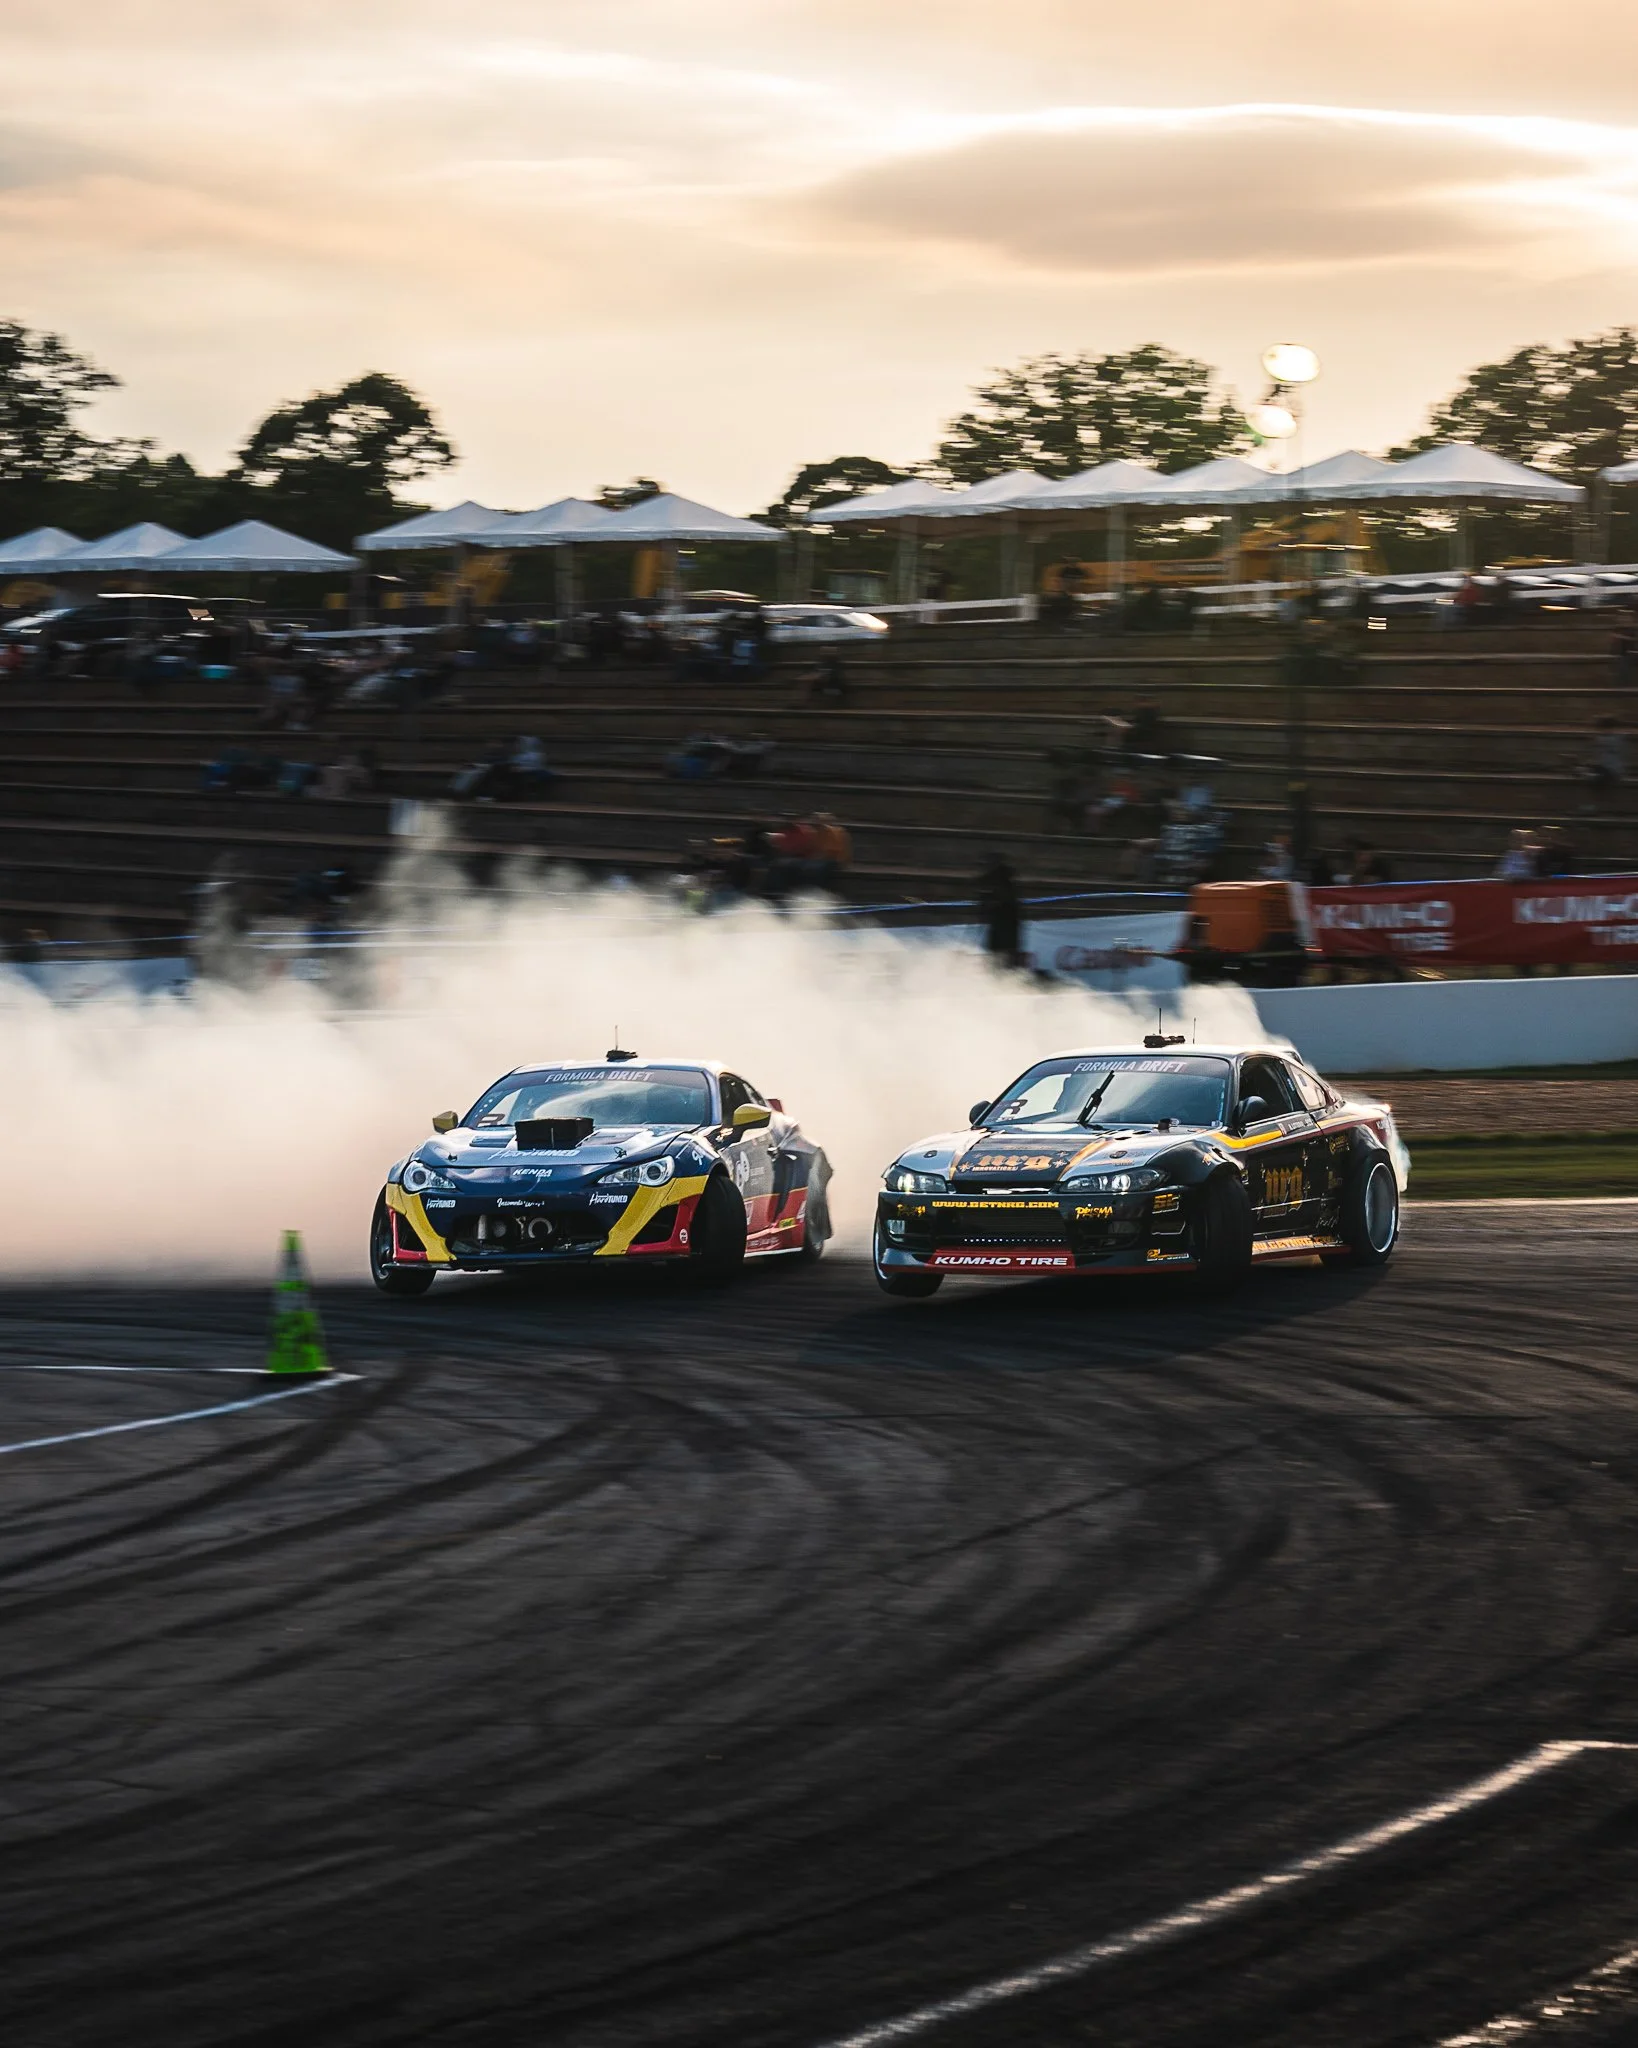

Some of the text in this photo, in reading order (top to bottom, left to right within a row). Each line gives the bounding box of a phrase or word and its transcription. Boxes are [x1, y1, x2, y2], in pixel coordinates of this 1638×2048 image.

[1313, 901, 1454, 928] KUMHO
[1074, 1060, 1187, 1073] FORMULA DRIFT
[545, 1071, 605, 1083] FORMULA
[607, 1070, 655, 1082] DRIFT
[512, 1169, 553, 1177] KENDA
[935, 1257, 1068, 1266] KUMHO TIRE
